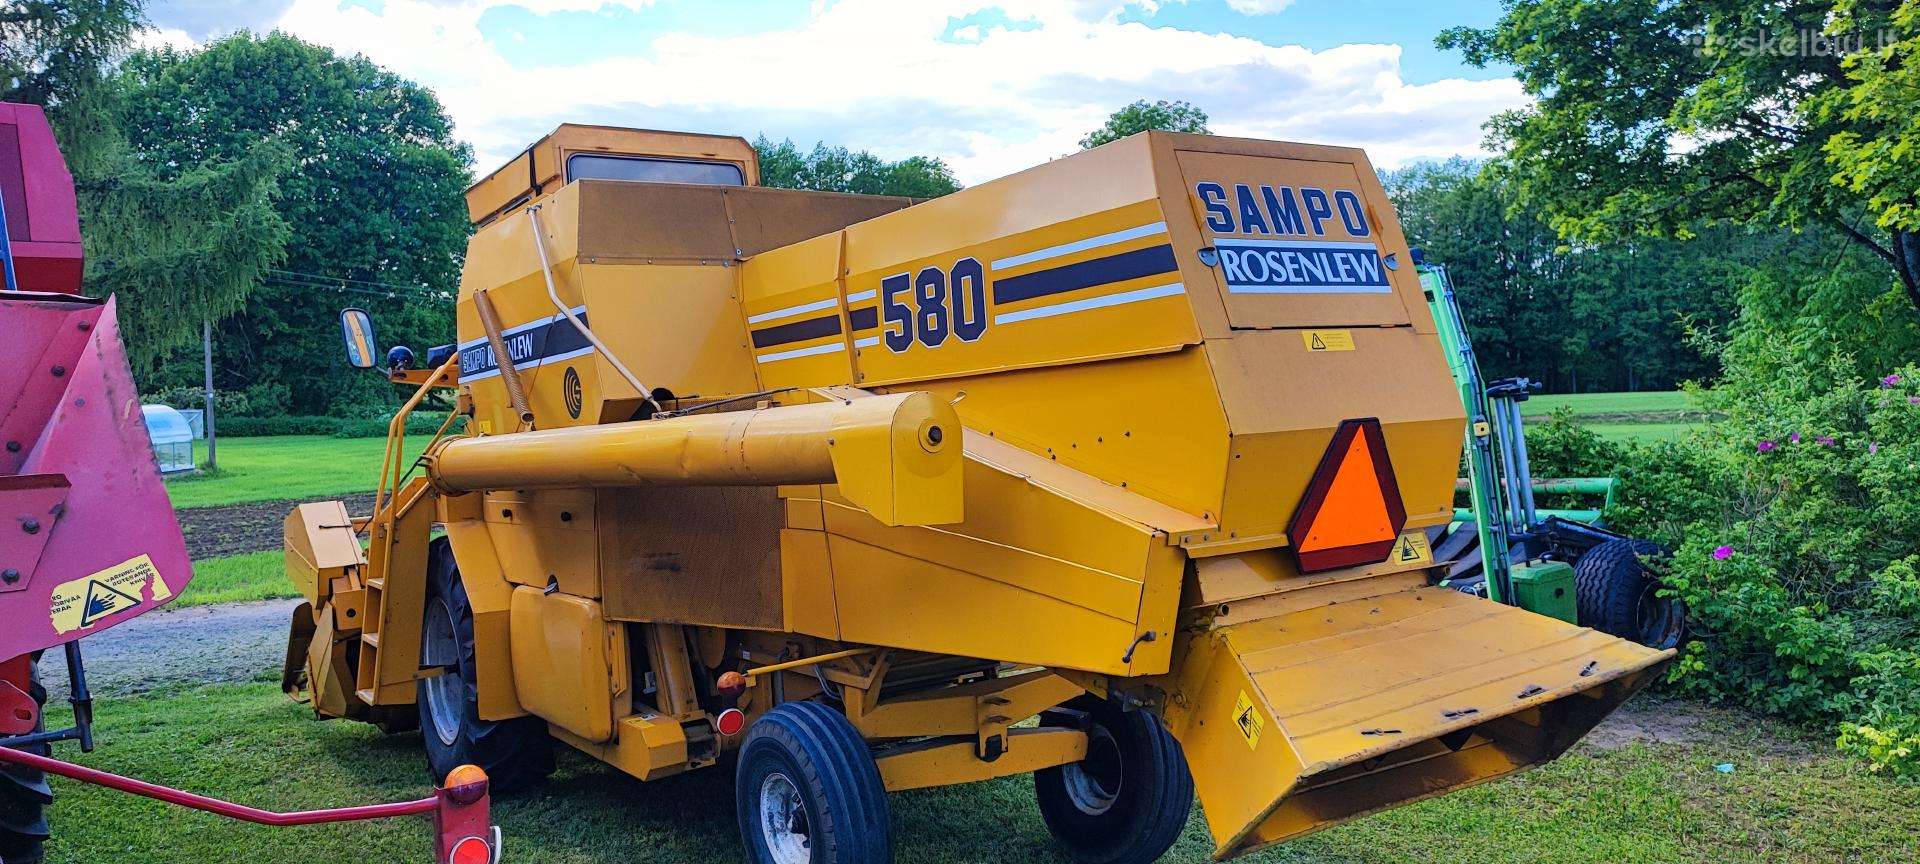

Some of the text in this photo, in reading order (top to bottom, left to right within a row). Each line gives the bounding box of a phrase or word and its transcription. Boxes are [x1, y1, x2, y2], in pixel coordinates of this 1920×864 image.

[1196, 182, 1371, 237] SAMPO
[1219, 249, 1381, 283] ROSENLEW
[880, 256, 988, 354] 580
[463, 332, 534, 374] SAMPO RNLEW
